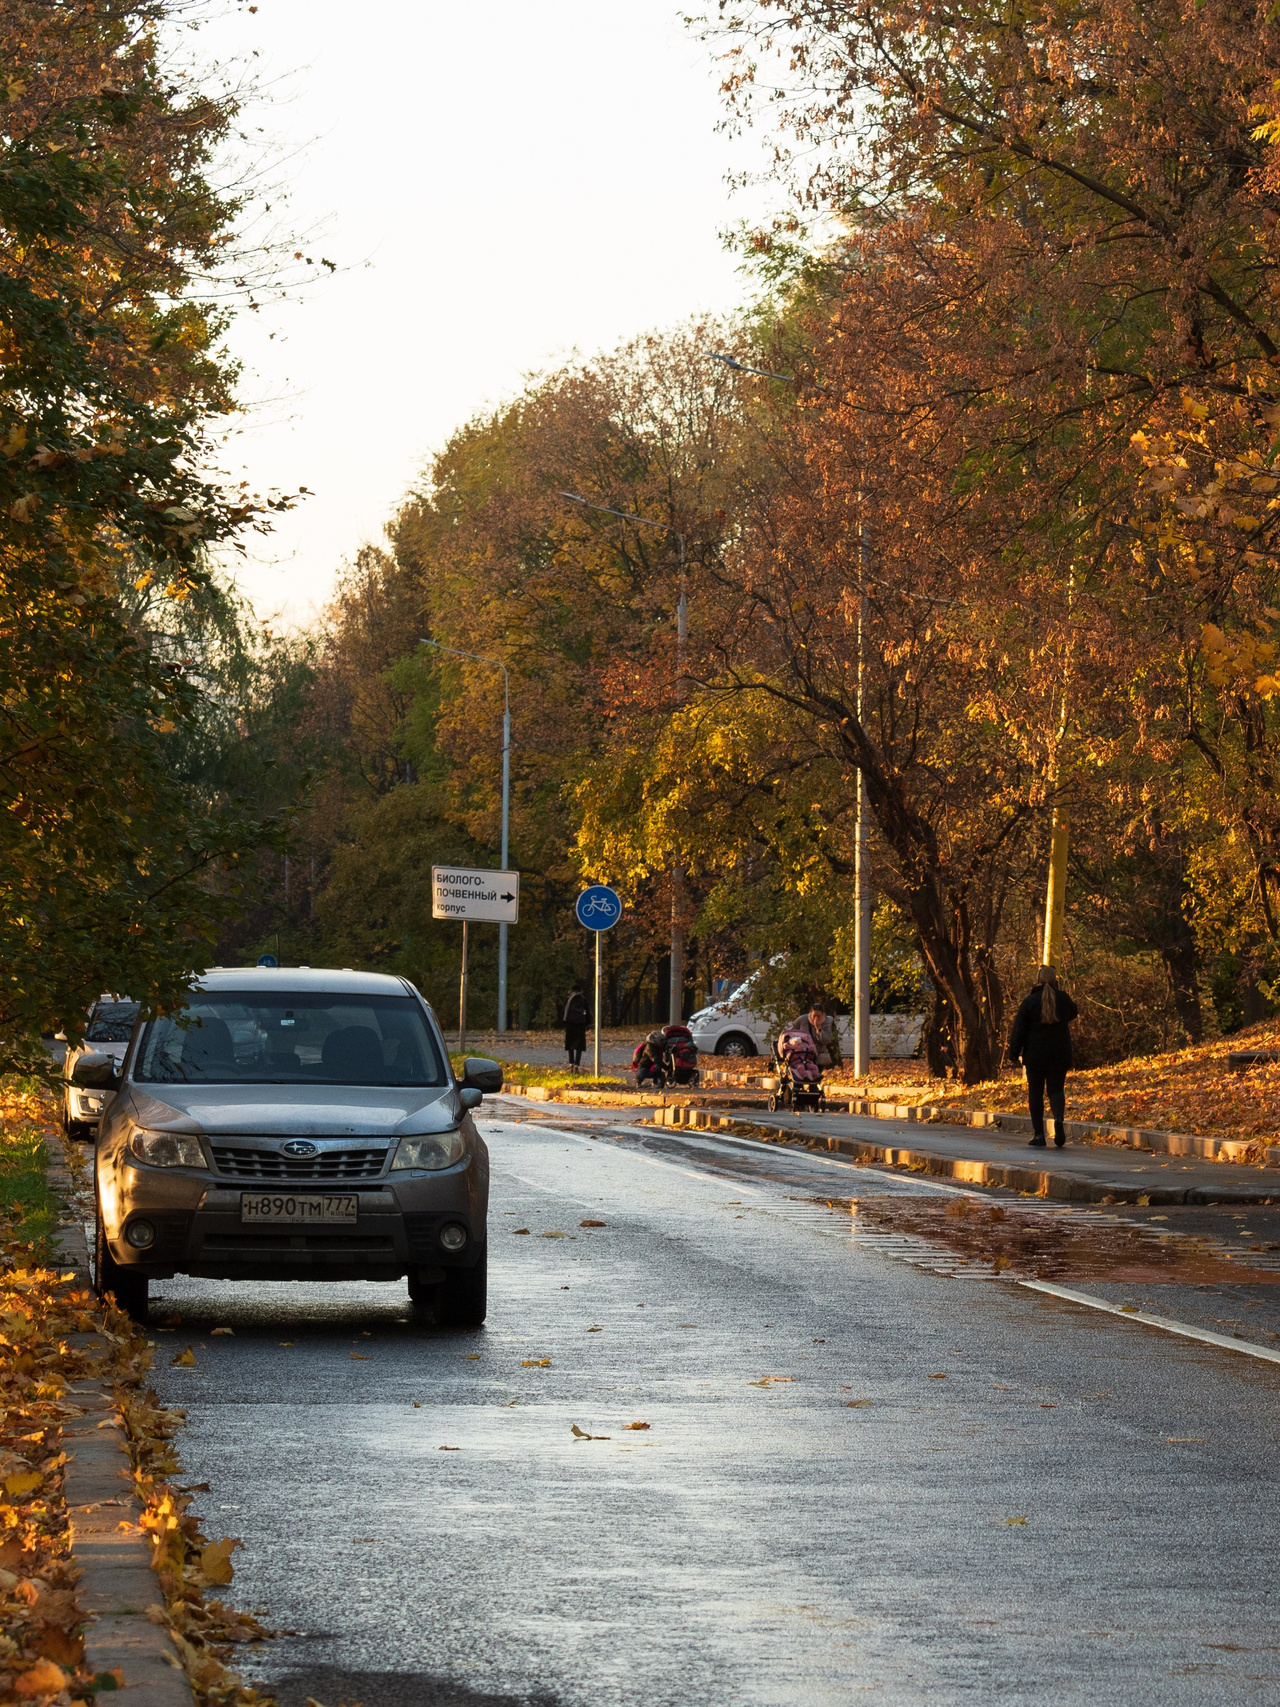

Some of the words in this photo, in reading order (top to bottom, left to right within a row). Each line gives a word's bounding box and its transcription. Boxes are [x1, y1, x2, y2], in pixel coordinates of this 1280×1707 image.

[436, 874, 485, 886] БИОЛОГО-
[436, 888, 497, 901] ПОЧВЕННЫЙ
[436, 903, 466, 914] корпус
[324, 1197, 352, 1211] 777
